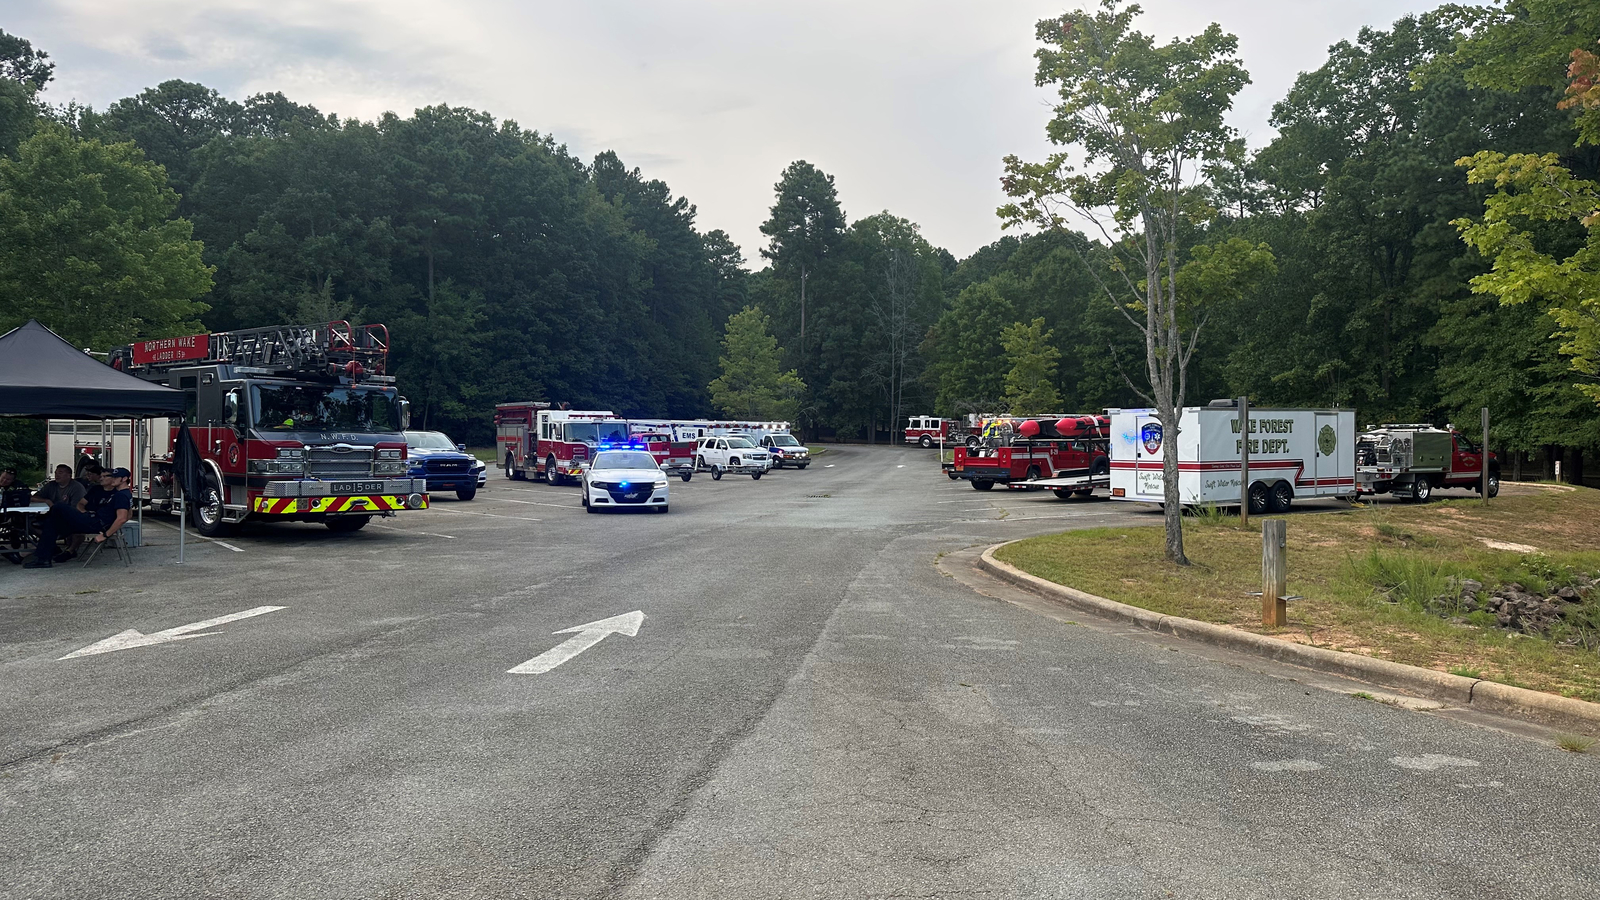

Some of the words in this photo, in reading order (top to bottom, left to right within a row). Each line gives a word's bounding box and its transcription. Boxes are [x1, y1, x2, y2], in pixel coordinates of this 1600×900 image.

[144, 340, 176, 353] NORTHERN
[178, 336, 196, 348] WAKE
[157, 351, 174, 360] LADDER
[1231, 419, 1257, 433] WE
[1259, 419, 1294, 433] FOREST
[682, 432, 696, 440] EMS
[1236, 439, 1259, 454] FRE
[1262, 439, 1290, 454] DEPT.
[1139, 472, 1151, 482] Swift
[1152, 473, 1164, 481] Wate
[333, 484, 352, 492] LAD
[353, 483, 363, 492] 15
[1144, 482, 1160, 490] Rescue
[1204, 480, 1217, 490] Swift
[1217, 479, 1230, 488] Water
[1230, 479, 1242, 487] Resc
